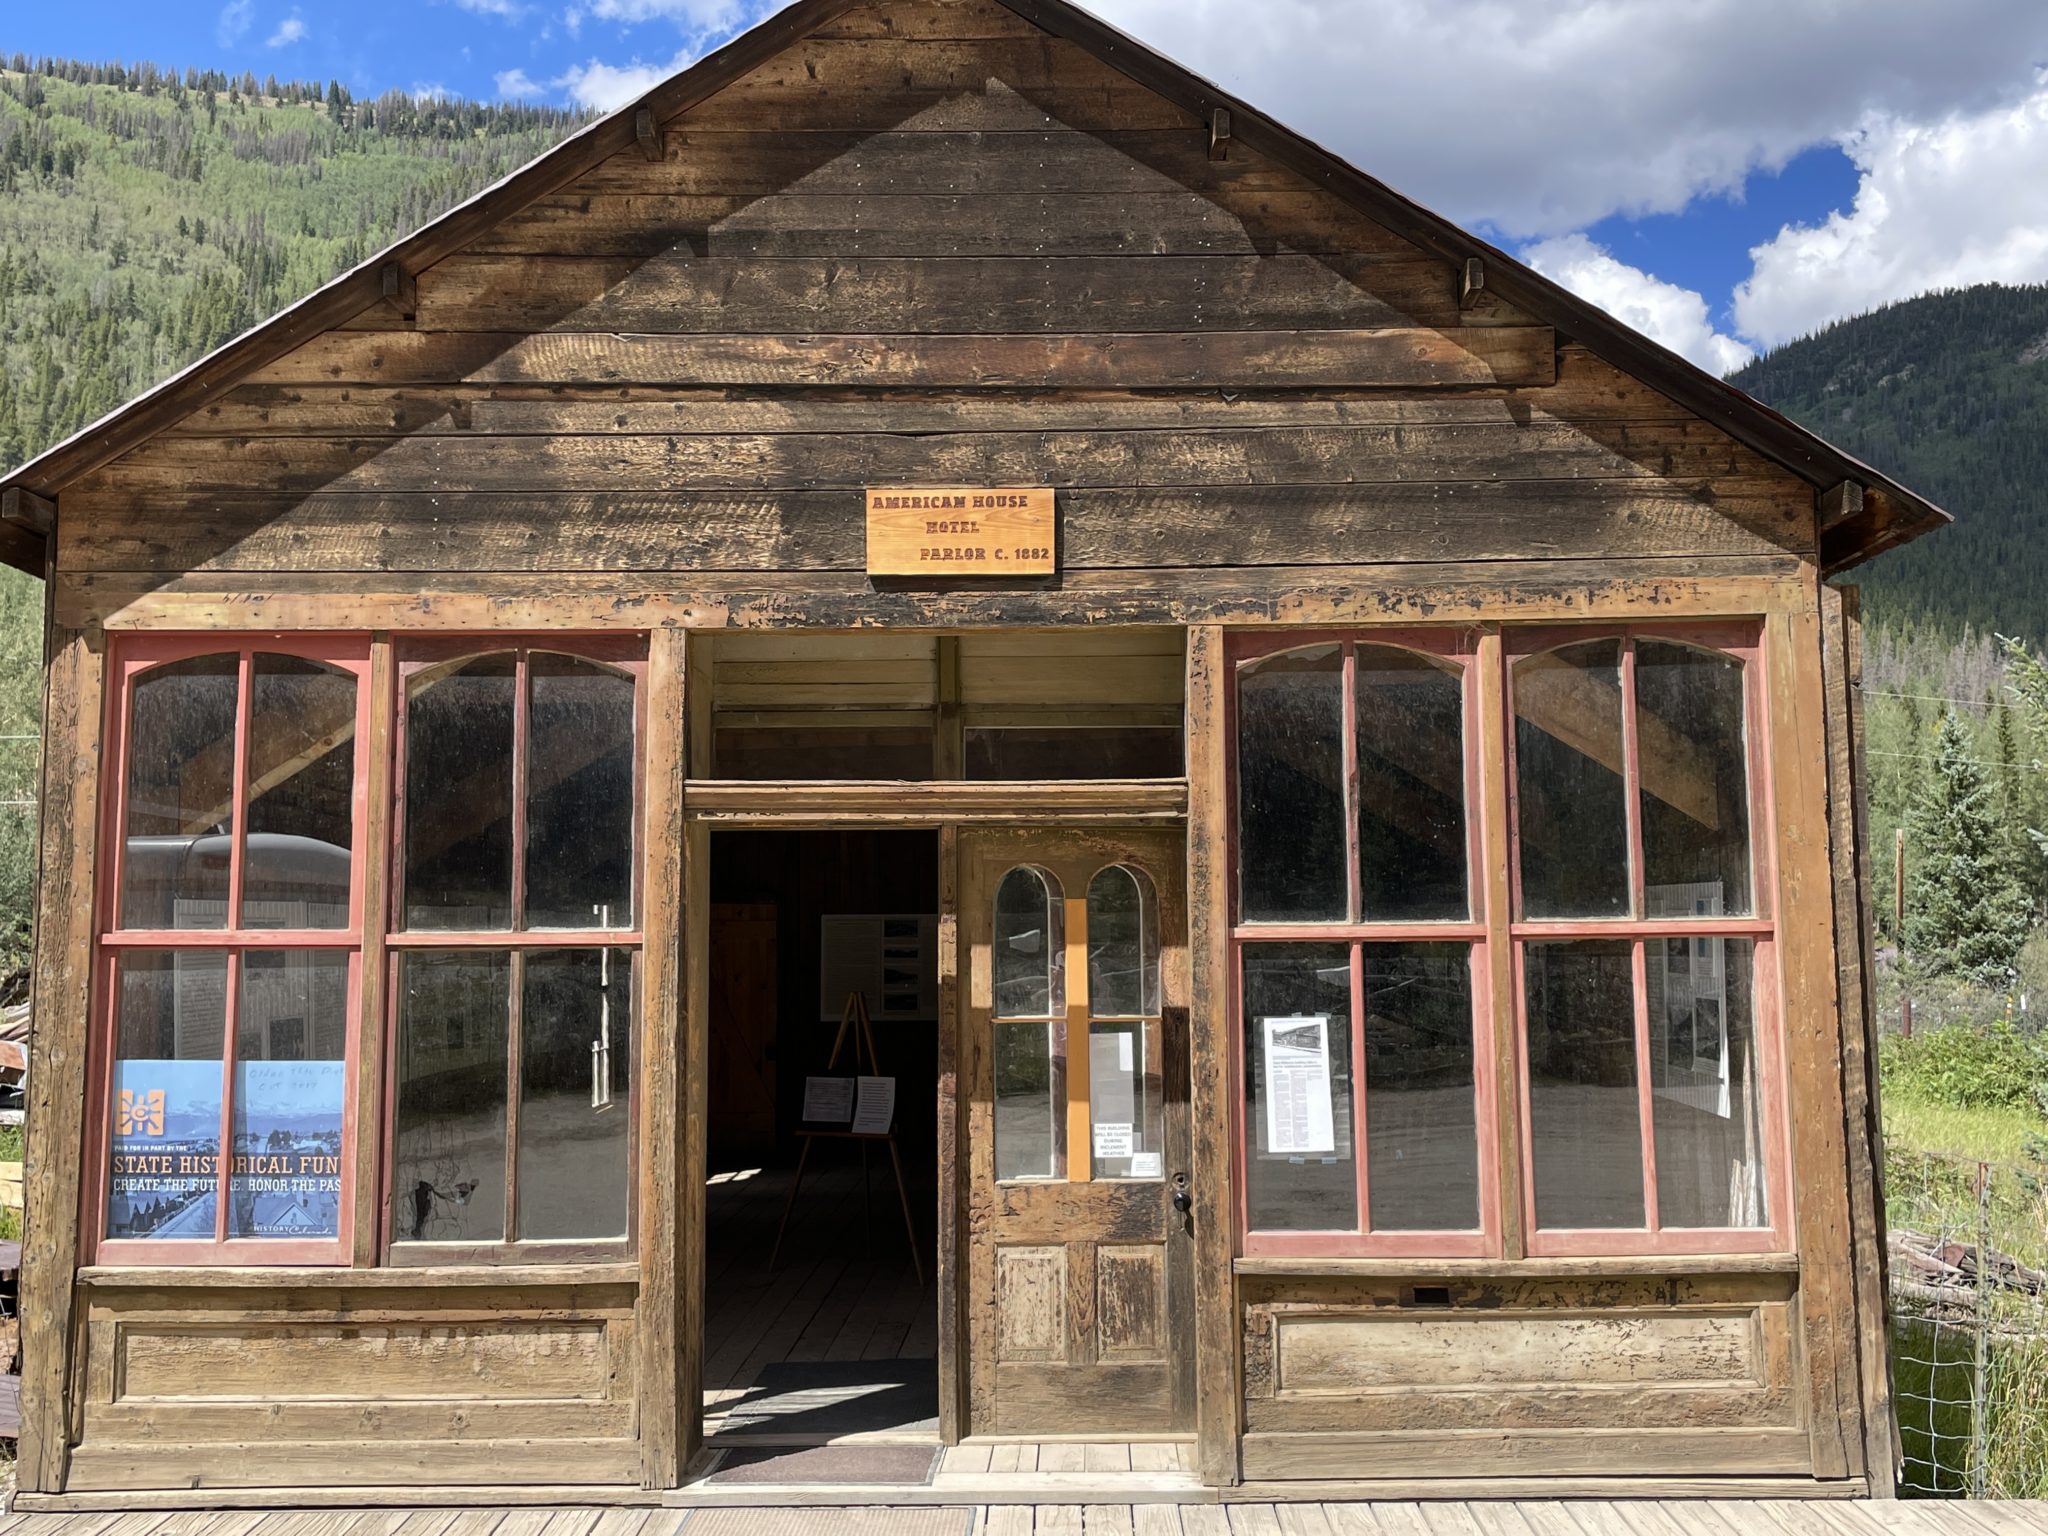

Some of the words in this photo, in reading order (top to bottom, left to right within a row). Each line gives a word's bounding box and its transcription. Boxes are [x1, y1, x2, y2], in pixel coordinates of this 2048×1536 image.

[872, 496, 967, 510] AMERICAN
[972, 495, 1029, 508] HOUSE
[926, 521, 980, 534] HOTEL
[920, 548, 986, 561] PARLOR
[994, 548, 1009, 560] C.
[1014, 547, 1050, 560] 1882
[114, 1156, 173, 1174] STATE
[113, 1179, 161, 1191] CREATE
[163, 1179, 188, 1191] THE
[248, 1179, 289, 1192] HONOR
[291, 1179, 316, 1191] THE
[288, 1224, 333, 1235] Colorado
